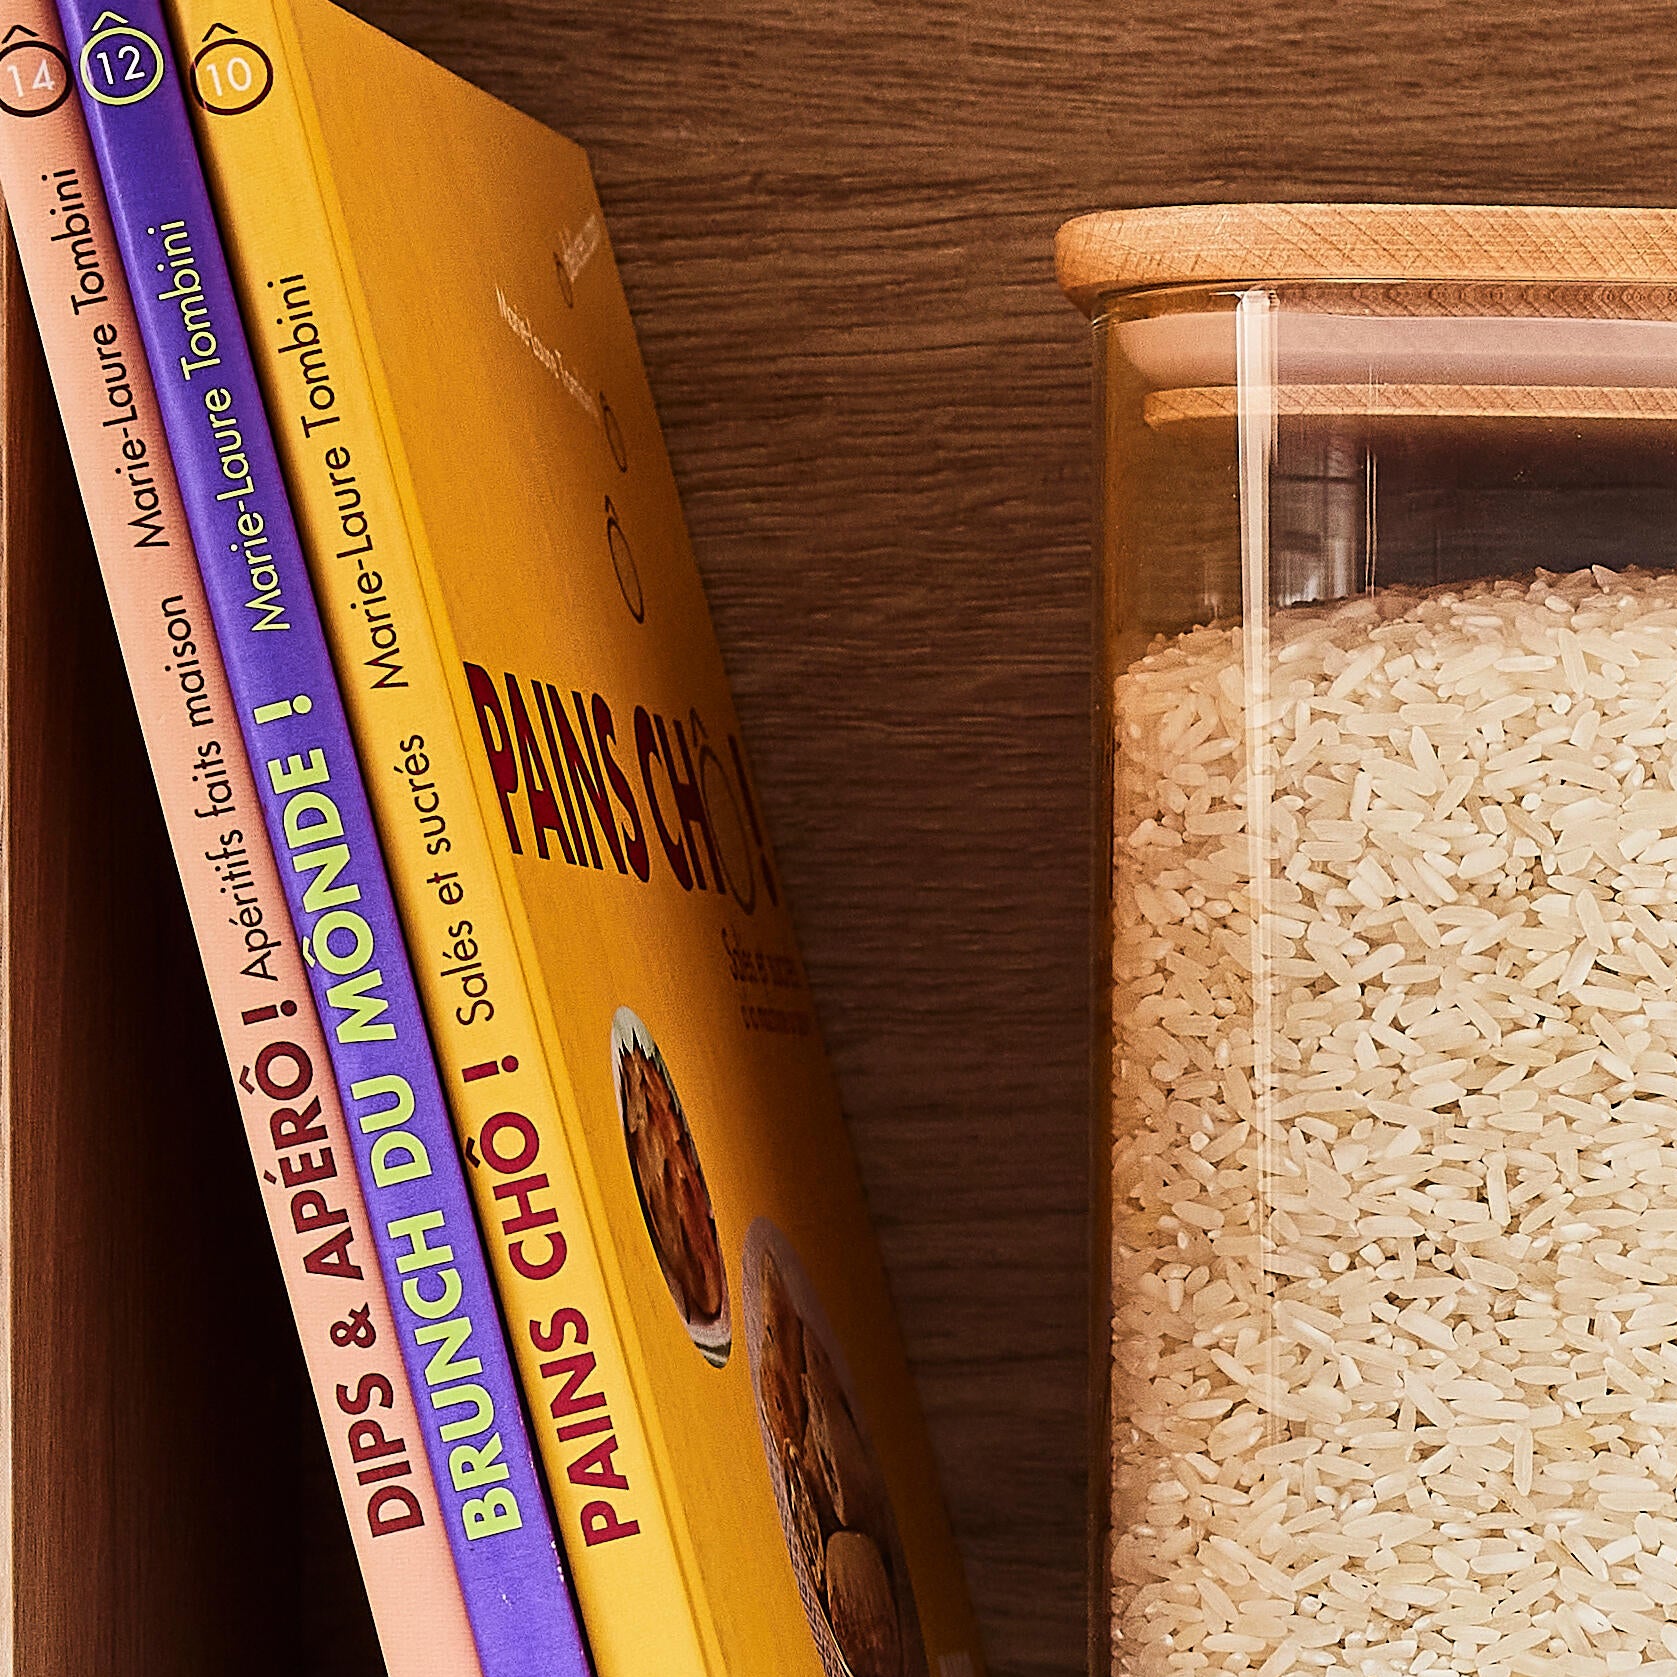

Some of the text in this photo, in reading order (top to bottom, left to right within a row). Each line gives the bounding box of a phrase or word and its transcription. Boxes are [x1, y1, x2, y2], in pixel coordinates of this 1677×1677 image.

[7, 59, 56, 98] 14
[96, 44, 146, 85] 12
[206, 57, 252, 97] 10
[41, 168, 171, 549] Marie-Laure Tombini
[147, 219, 291, 632] Marie-Laure Tombini
[267, 273, 410, 690] Marie-Laure Tombini
[161, 595, 283, 983] Apéritifs faits maison
[393, 733, 496, 1027] Salés et sucrés
[462, 660, 651, 884] PAINS
[634, 705, 758, 916] CHÔ
[239, 998, 425, 1539] DIPS & APÉRÔ !
[252, 694, 525, 1543] BRUNCH DU MÔNDE !
[462, 1054, 641, 1549] PAINS CHÔ !
